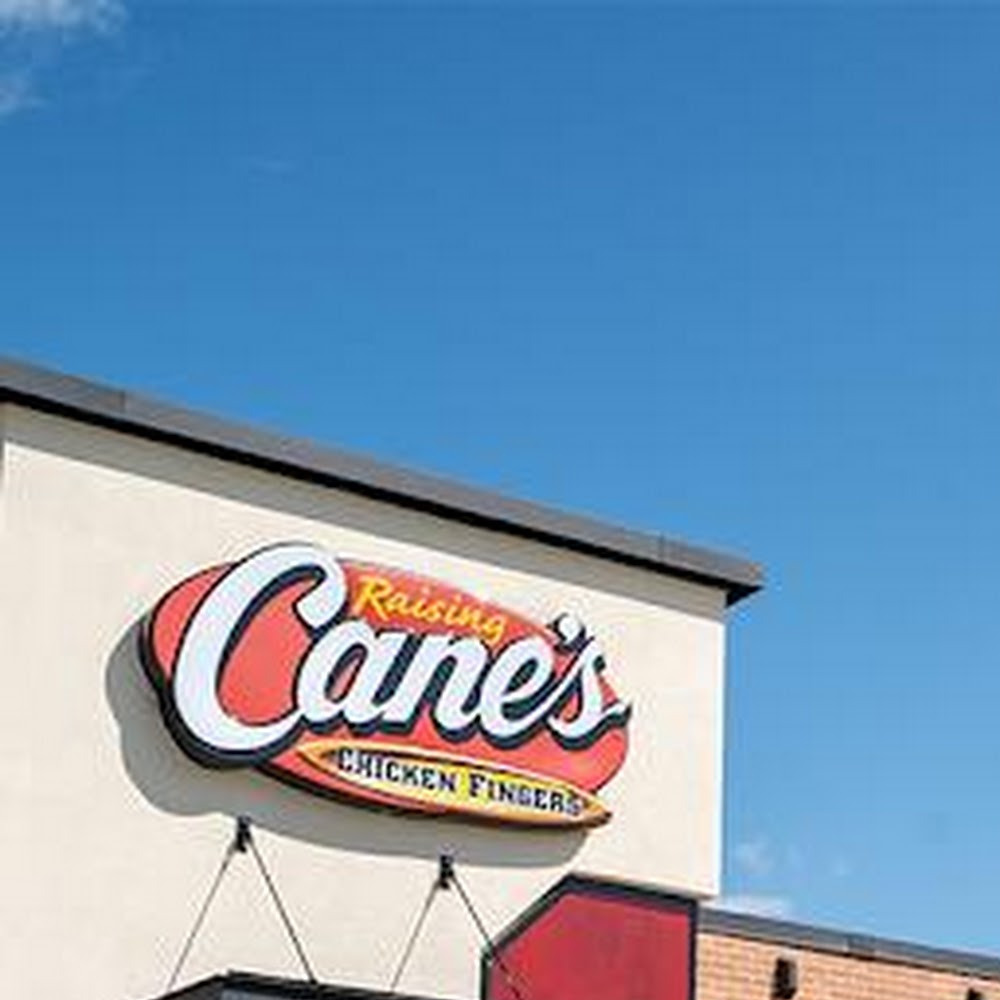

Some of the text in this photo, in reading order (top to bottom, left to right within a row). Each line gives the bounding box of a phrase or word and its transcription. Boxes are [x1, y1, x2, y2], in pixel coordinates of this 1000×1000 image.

[352, 574, 507, 645] Raising
[172, 542, 630, 750] Cane's
[337, 746, 586, 818] CHICKEN FINGERS
